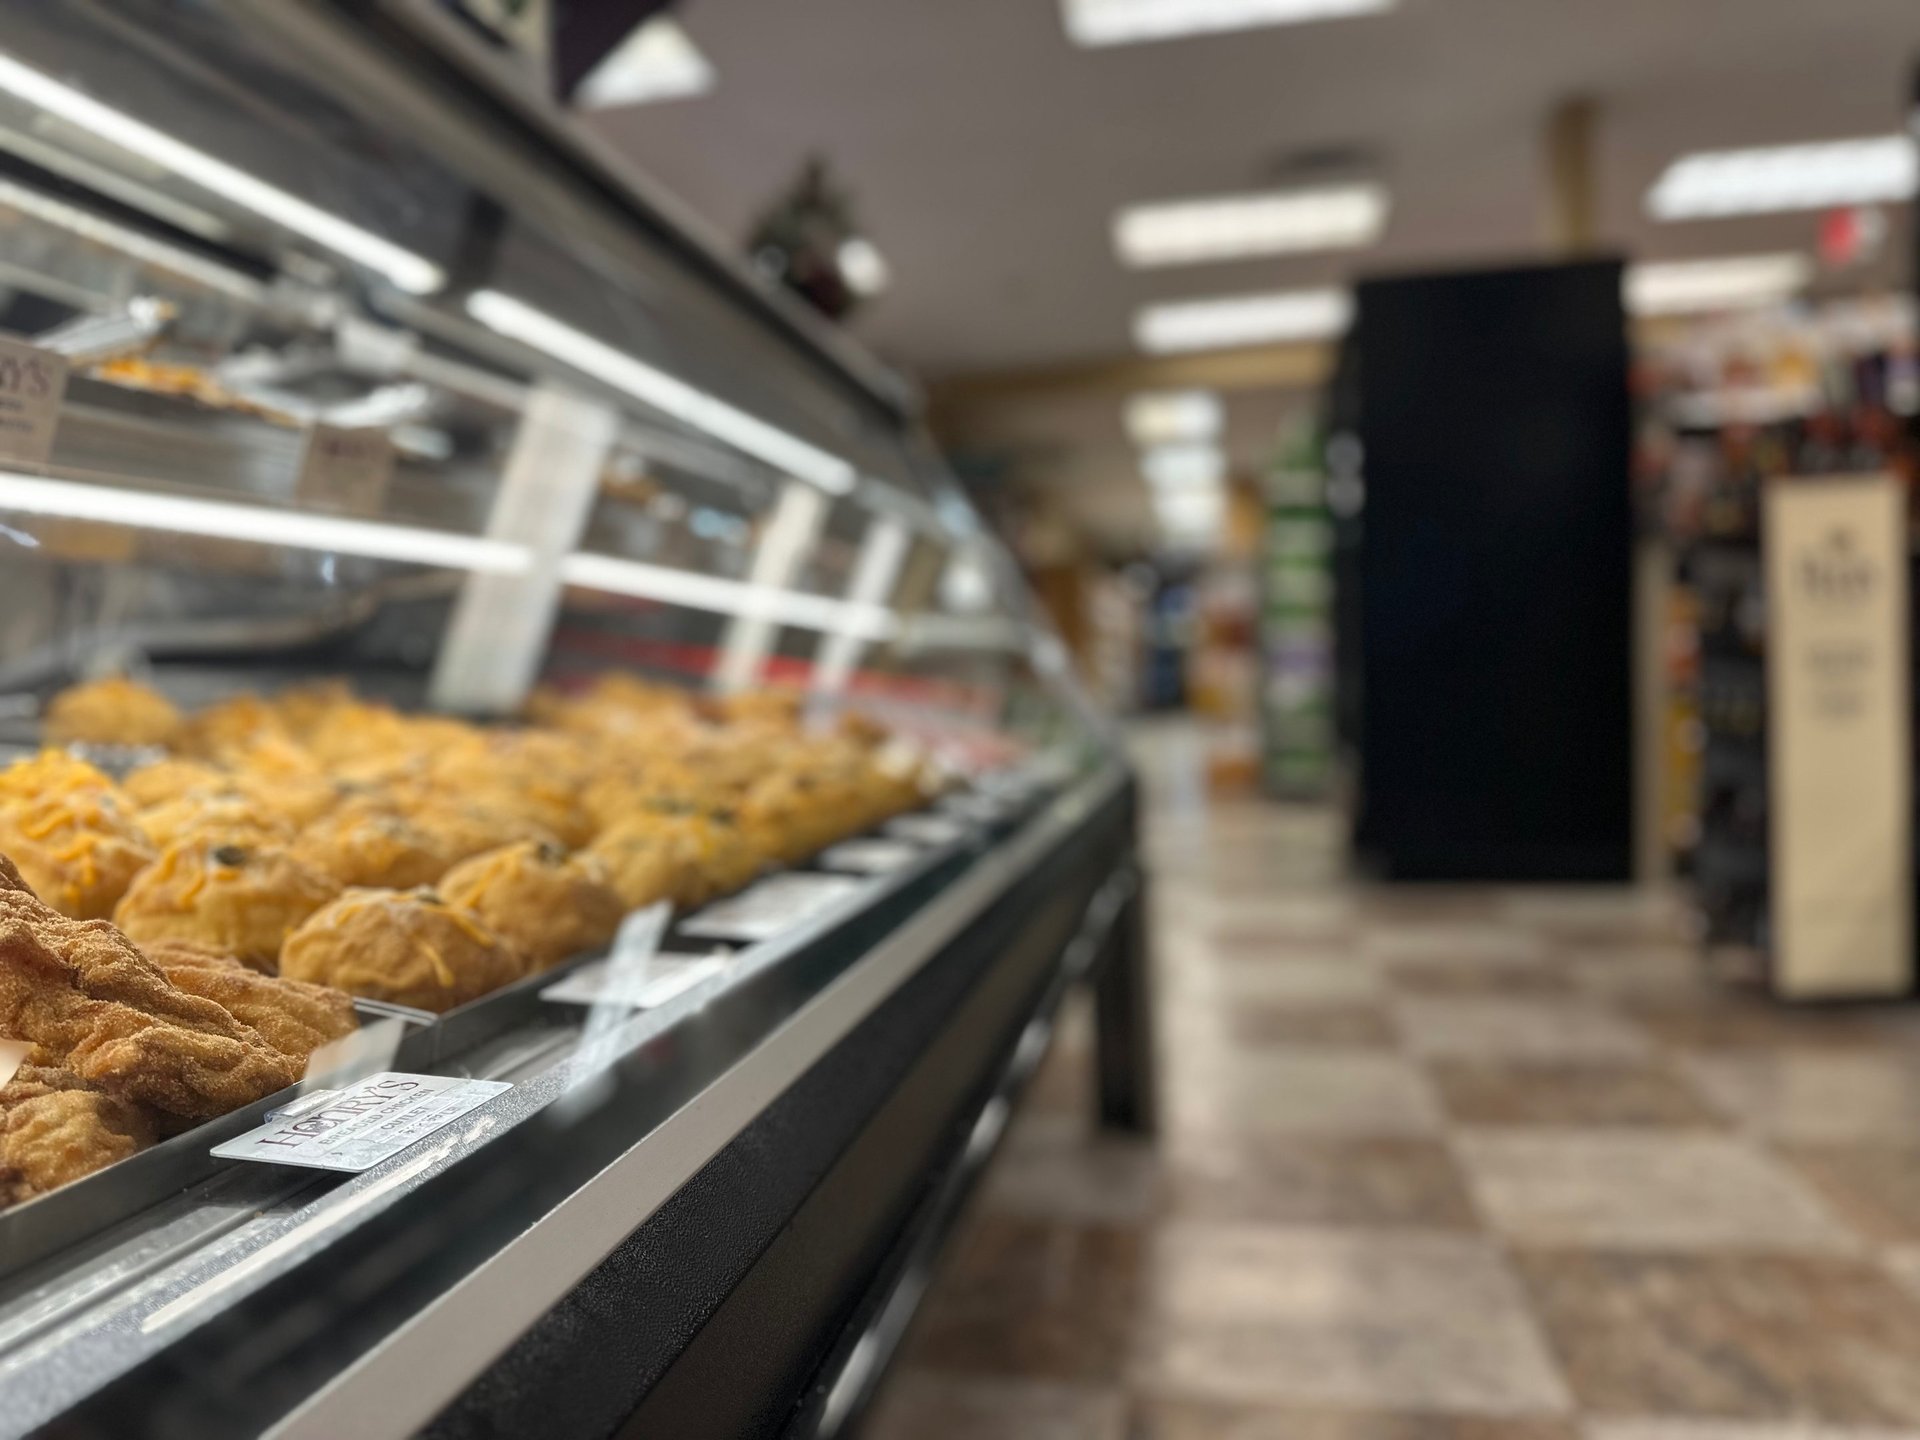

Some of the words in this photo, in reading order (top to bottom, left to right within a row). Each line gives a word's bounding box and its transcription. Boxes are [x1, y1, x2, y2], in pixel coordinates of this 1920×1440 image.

[318, 1113, 383, 1145] BREADED
[380, 1088, 435, 1114] CHICKEN
[380, 1105, 430, 1130] CUTLET
